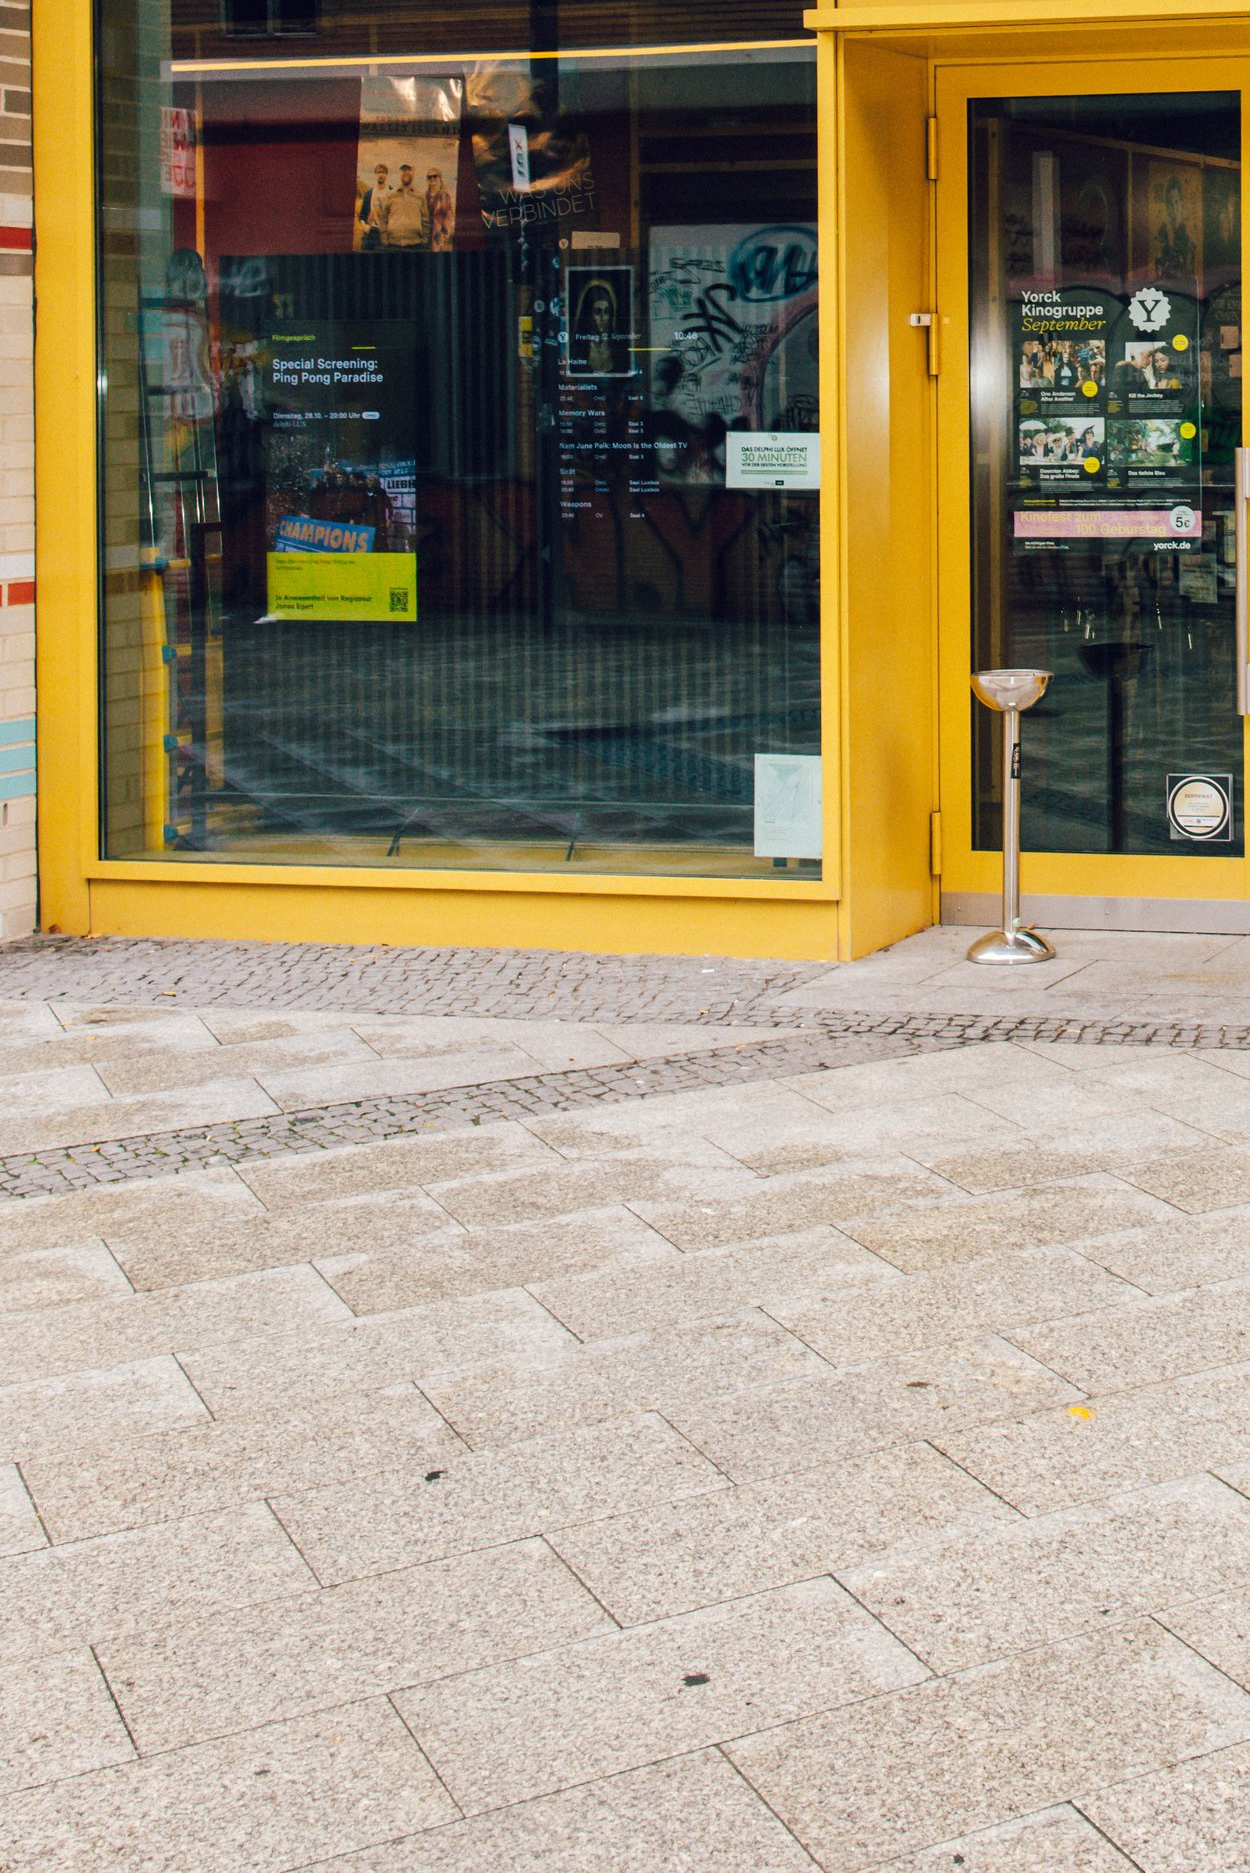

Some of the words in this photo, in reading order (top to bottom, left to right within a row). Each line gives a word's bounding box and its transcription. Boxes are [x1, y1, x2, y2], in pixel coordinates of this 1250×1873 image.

[481, 192, 597, 230] VERBINDET
[1021, 290, 1062, 303] Yorck
[1021, 304, 1104, 319] Kinogruppe
[1021, 317, 1106, 335] September
[272, 357, 315, 372] Special
[317, 357, 379, 372] Screening:
[272, 372, 299, 386] Ping
[301, 372, 331, 386] Pong
[333, 371, 384, 383] Paradise
[558, 409, 586, 417] Memory
[653, 441, 677, 449] Oldest
[741, 452, 755, 462] 30
[756, 452, 808, 463] MINUTEN
[1019, 511, 1072, 522] Kinofest
[1075, 512, 1101, 522] zum
[279, 519, 369, 553] CHAMPIONS
[1153, 541, 1192, 551] yorck.de
